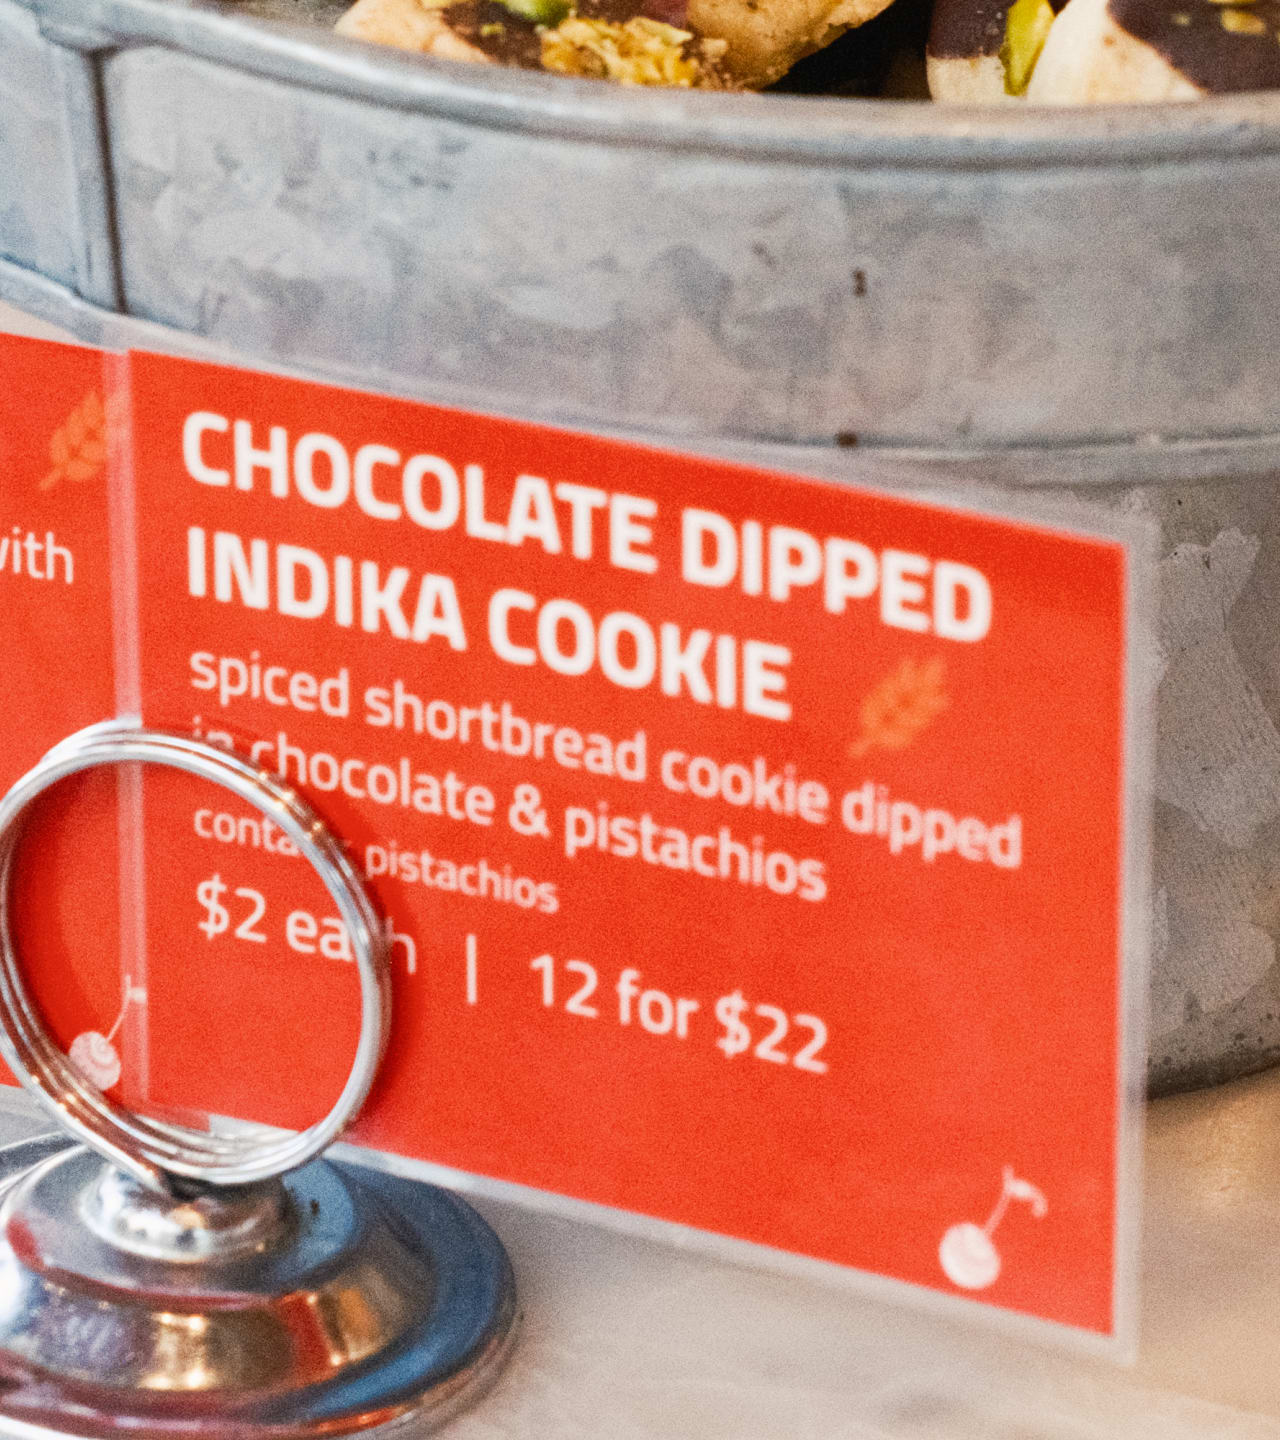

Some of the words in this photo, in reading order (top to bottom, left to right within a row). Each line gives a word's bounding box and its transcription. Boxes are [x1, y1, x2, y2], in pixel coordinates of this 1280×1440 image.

[181, 410, 659, 575] CHOCOLATE
[680, 506, 993, 645] DIPPED
[186, 524, 468, 653] INDIKA
[487, 587, 793, 722] COOKIE
[189, 649, 351, 719] spiced
[364, 680, 648, 783] shortbread
[659, 749, 830, 825] cookie
[841, 782, 1023, 870] dipped
[250, 731, 496, 827] chocolate
[507, 783, 552, 839] &
[564, 801, 828, 902] pistachios
[193, 808, 352, 853] conta
[365, 840, 560, 914] pistachios
[195, 873, 268, 945] $2
[286, 910, 418, 976] eah
[529, 952, 600, 1020] 12
[614, 966, 700, 1040] for
[713, 988, 830, 1075] $22
